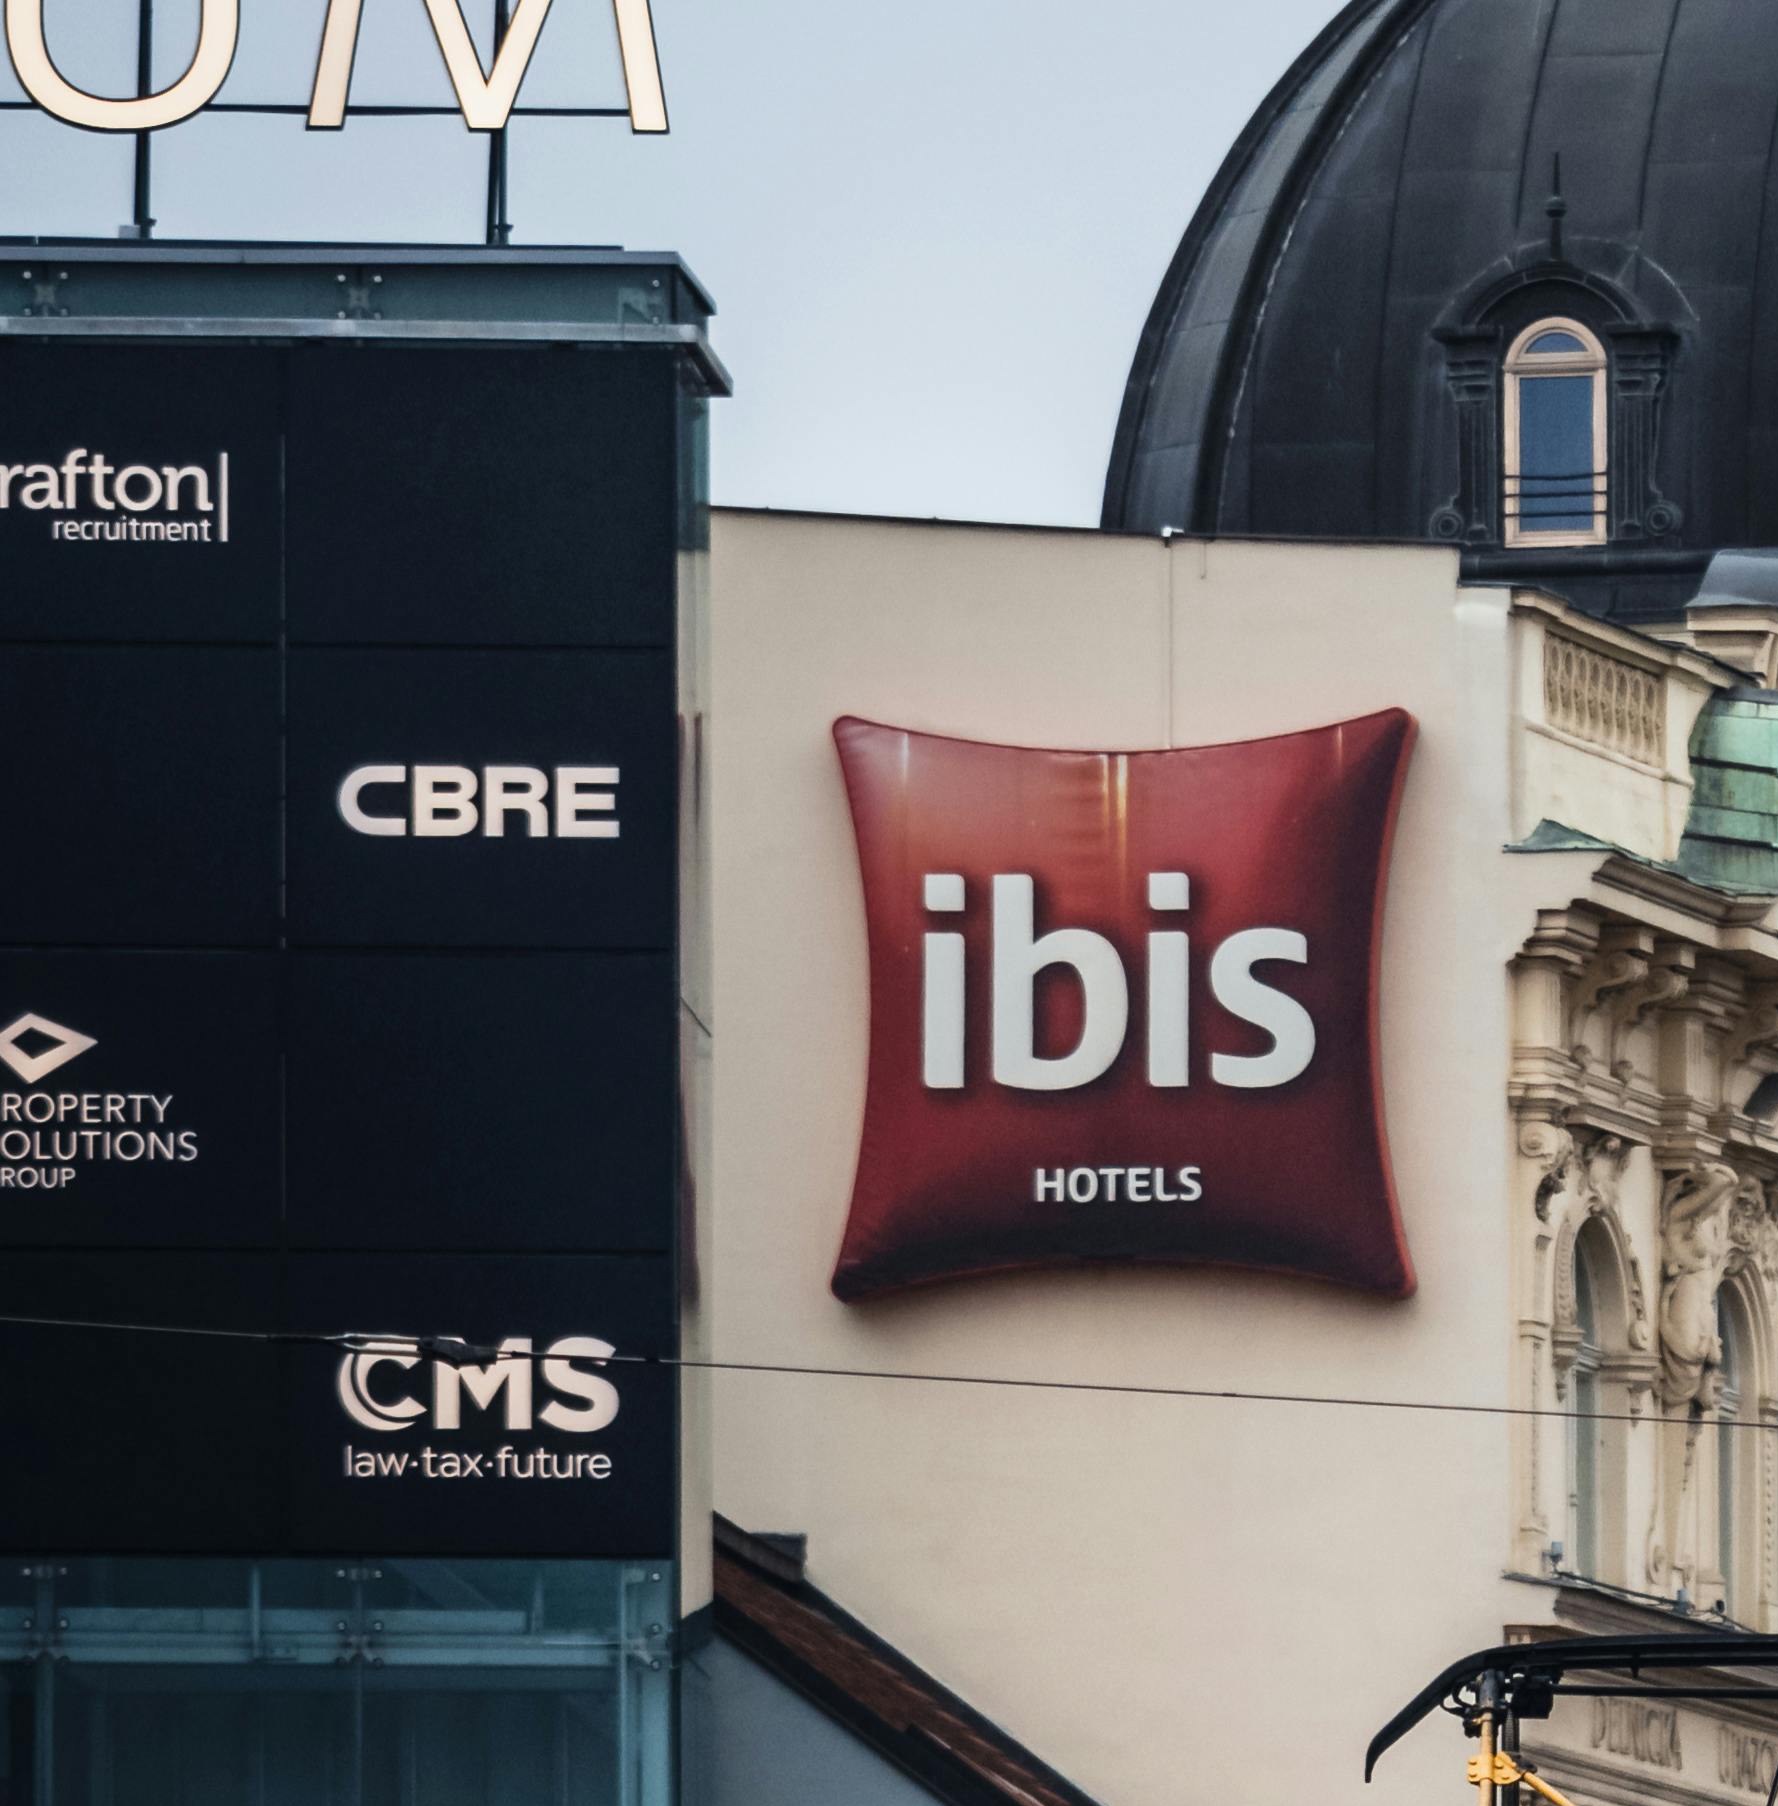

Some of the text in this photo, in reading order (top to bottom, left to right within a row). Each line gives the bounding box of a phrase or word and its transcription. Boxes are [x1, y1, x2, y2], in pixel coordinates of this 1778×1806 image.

[0, 448, 214, 512] rafton
[51, 514, 213, 543] recruitment
[337, 764, 621, 839] CBRE
[922, 871, 1317, 1091] ibis
[1, 1092, 174, 1124] ROPERTY
[0, 1130, 199, 1161] OLUTIONS
[0, 1166, 76, 1189] ROUP
[1035, 1166, 1202, 1205] HOTELS
[337, 1335, 620, 1433] CMS
